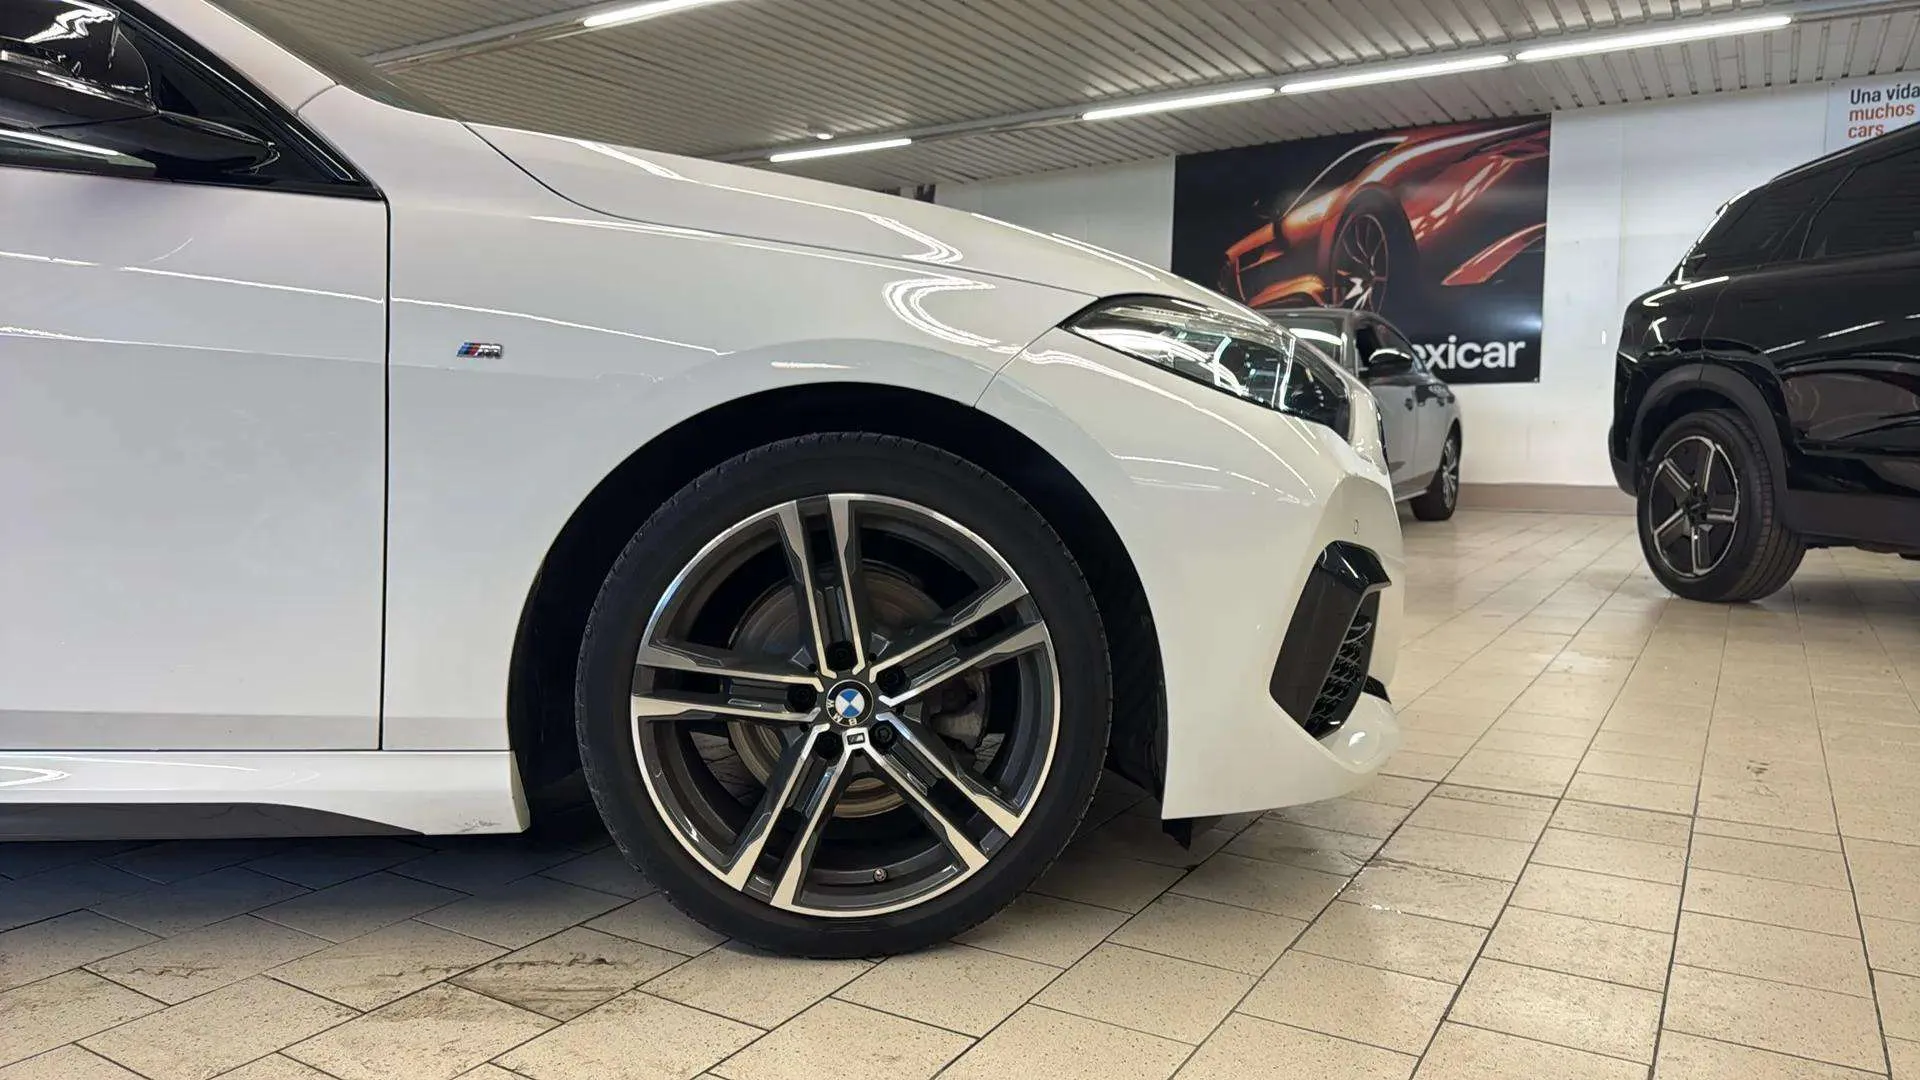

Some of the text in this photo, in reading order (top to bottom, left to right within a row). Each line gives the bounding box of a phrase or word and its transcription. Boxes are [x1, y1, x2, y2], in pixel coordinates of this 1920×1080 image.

[1850, 83, 1920, 104] Una vida
[1849, 103, 1914, 121] muchos
[1848, 124, 1884, 138] cars
